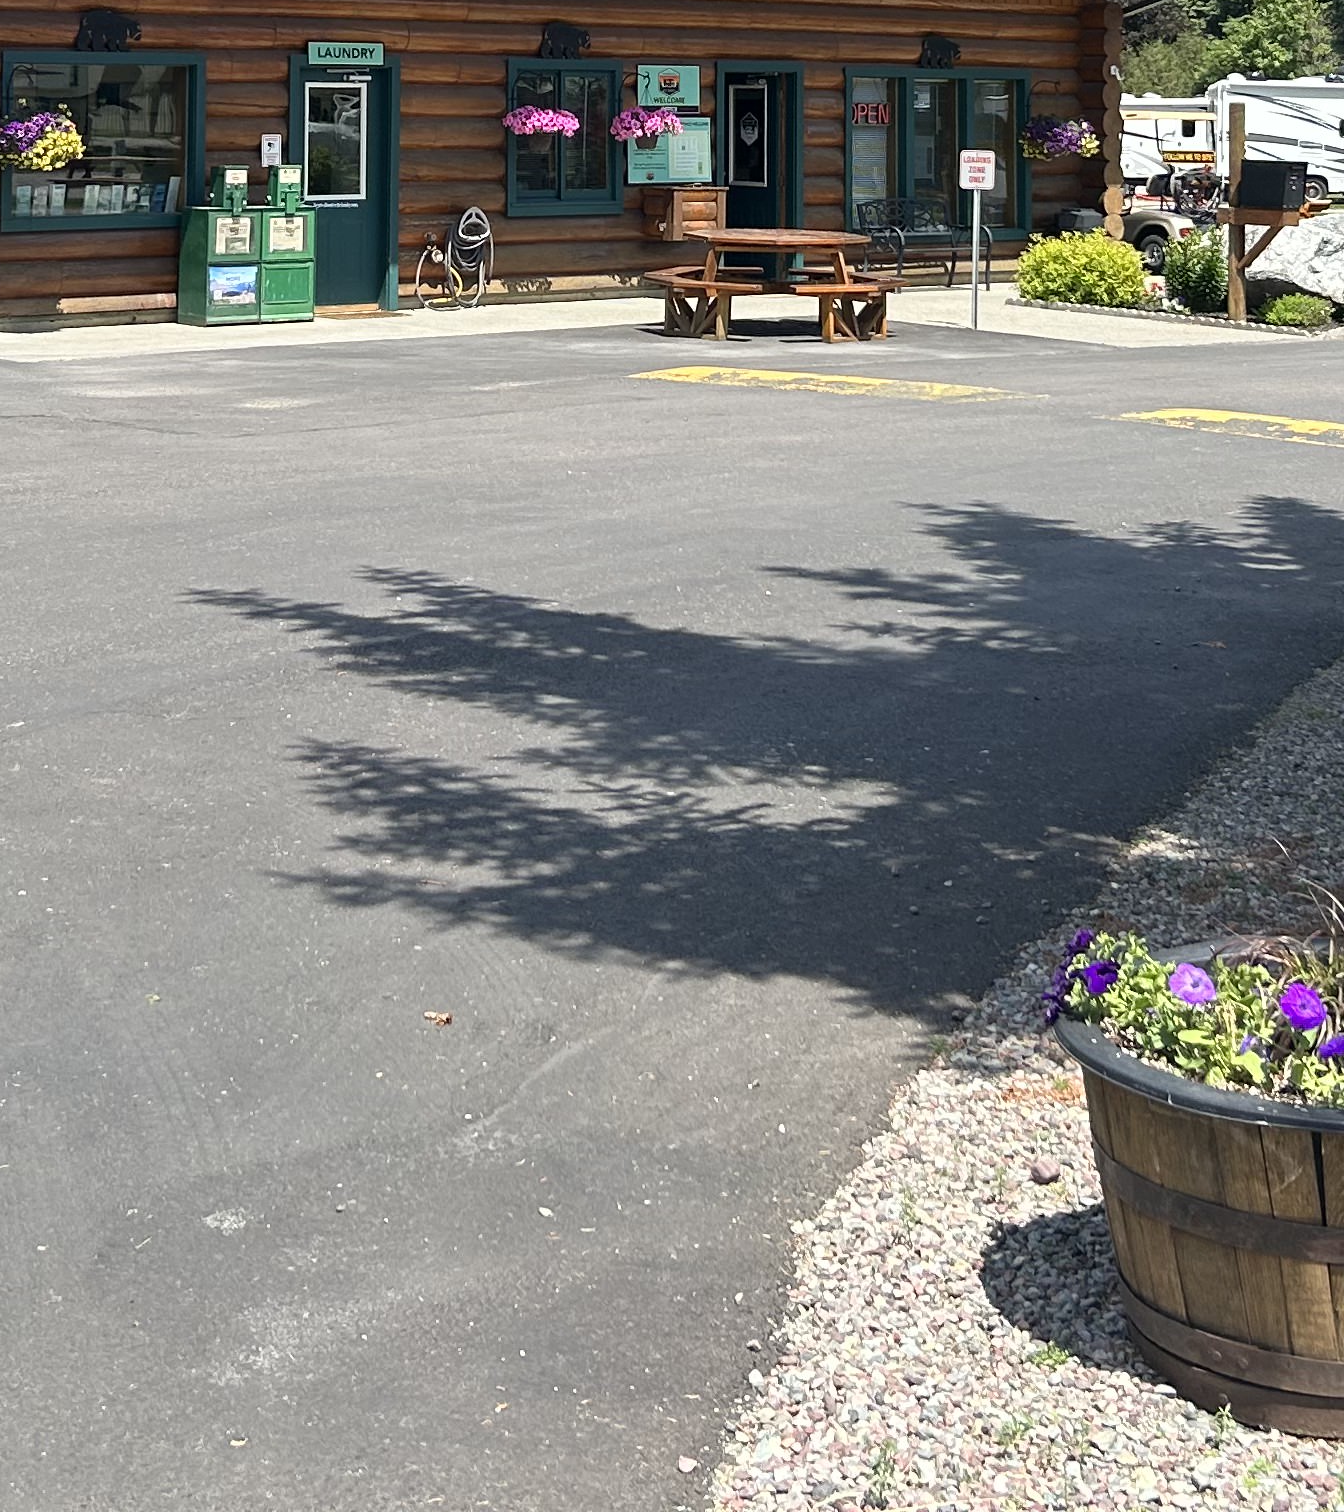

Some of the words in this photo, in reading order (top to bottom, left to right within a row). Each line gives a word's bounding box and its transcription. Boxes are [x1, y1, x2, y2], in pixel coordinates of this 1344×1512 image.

[317, 46, 376, 60] LAUNDRY
[653, 96, 685, 105] WELCOME
[963, 155, 992, 164] LOADING
